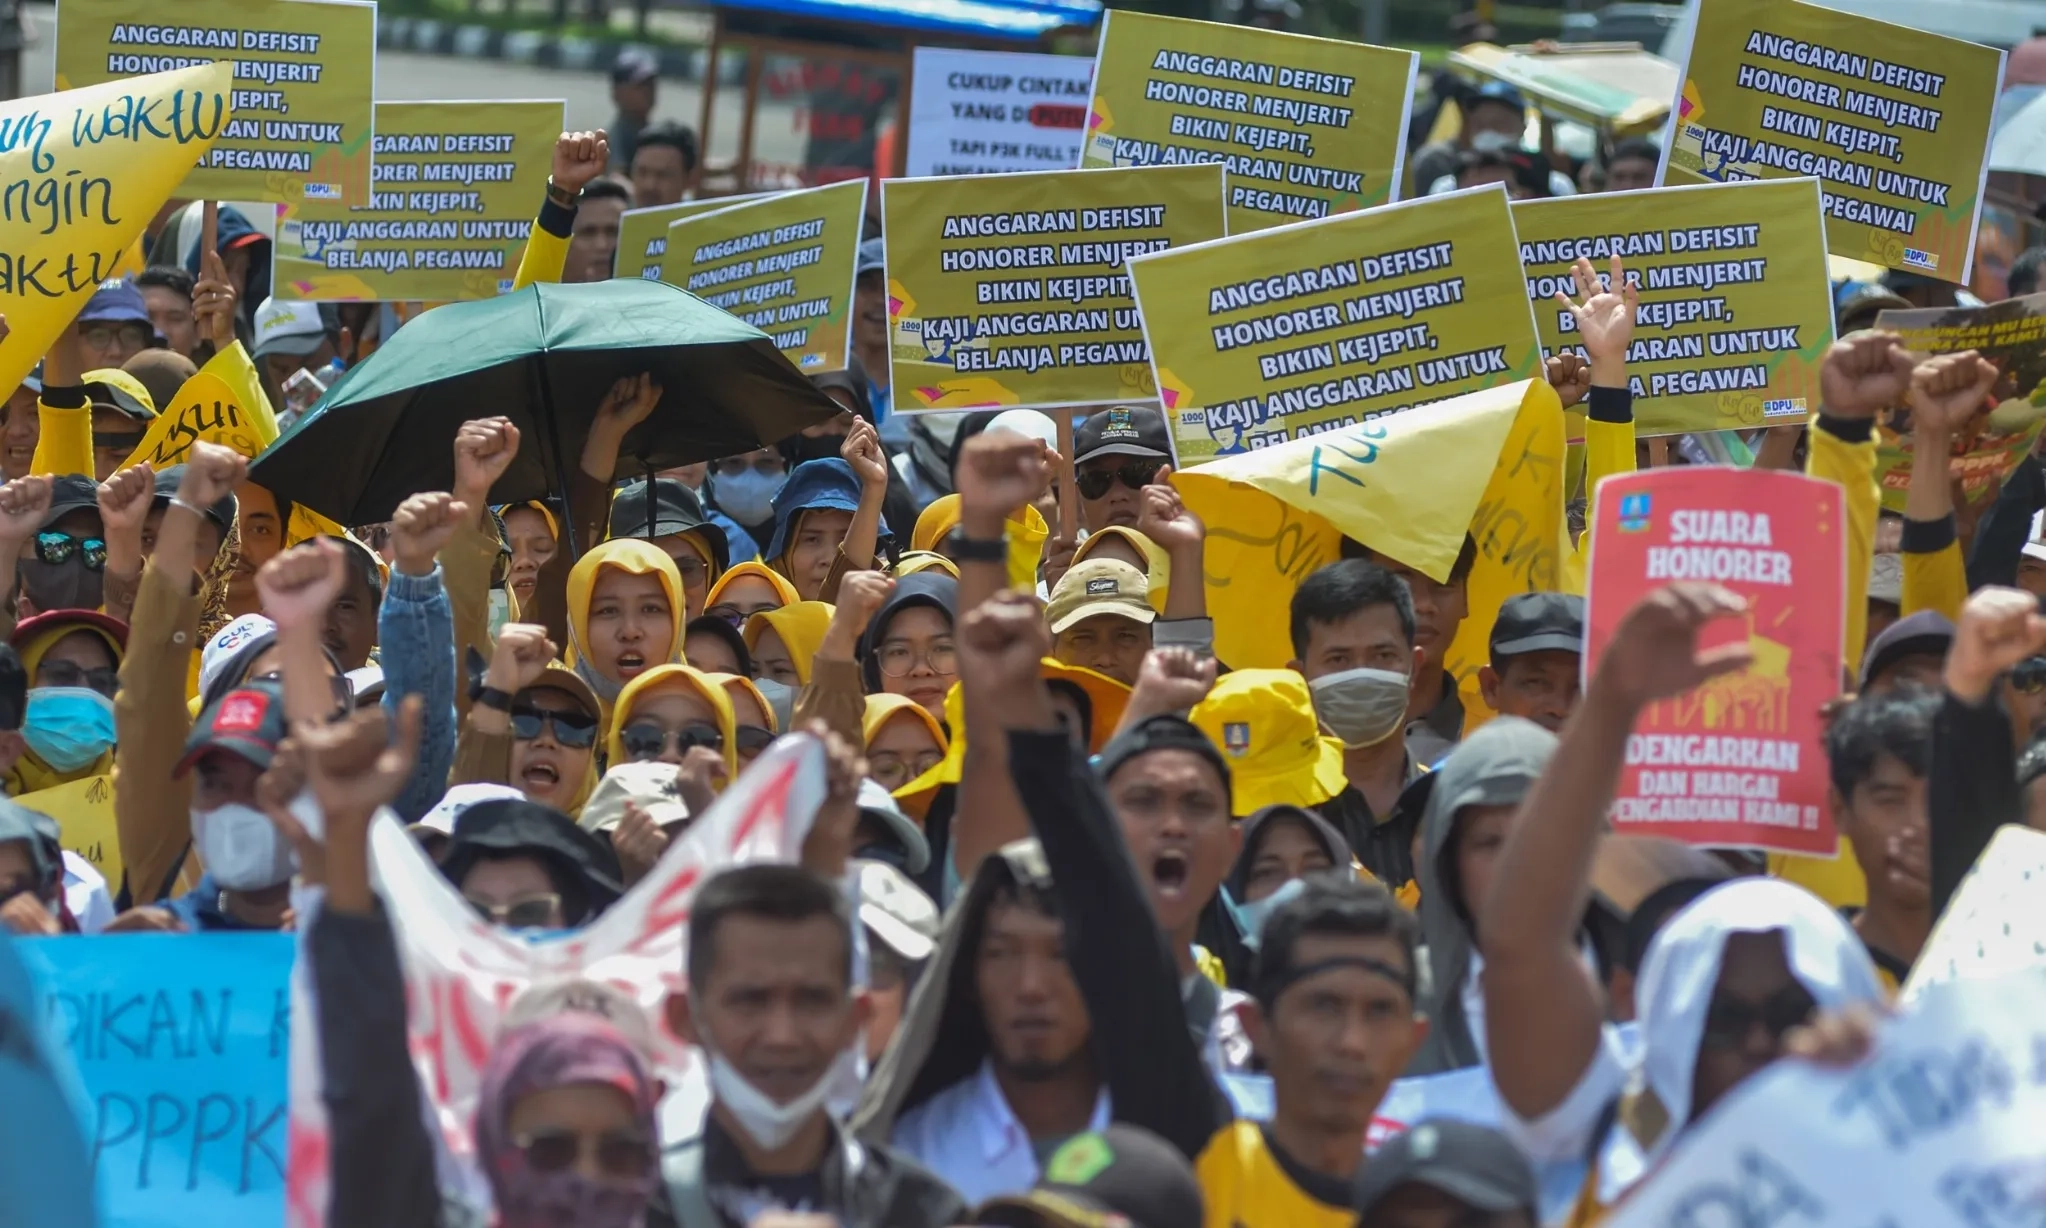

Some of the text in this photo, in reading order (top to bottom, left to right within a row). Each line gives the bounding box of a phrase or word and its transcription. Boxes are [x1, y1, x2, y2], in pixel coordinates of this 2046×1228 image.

[111, 24, 319, 53] ANGGARAN DEFISIT
[1153, 50, 1353, 97] ANGGARAN DEFISIT
[1746, 31, 1946, 97] ANGGARAN DEFISIT
[947, 72, 1013, 91] CUKUP
[951, 103, 1006, 122] YANG
[1146, 80, 1351, 128] HONORER MENJERIT
[1738, 65, 1941, 132] HONORER MENJERIT
[265, 122, 342, 142] UNTUK
[373, 135, 513, 152] GARAN DEFISIT
[1170, 115, 1315, 156] BIKIN KEJEPIT,
[1685, 125, 1704, 138] 1000
[1761, 107, 1903, 161] BIKIN KEJEPIT,
[211, 150, 311, 172] PEGAWAI
[373, 164, 514, 184] ORER MENJERIT
[1115, 138, 1158, 165] KAJI
[1288, 164, 1363, 192] UNTUK
[1704, 128, 1949, 207] KAJI ANGGARAN UNTUK
[408, 192, 484, 213] KEJEPIT,
[1232, 187, 1329, 218] PEGAWAI
[1822, 193, 1916, 235] PEGAWAI
[303, 222, 341, 243] KAJI
[348, 222, 457, 239] ANGGARAN
[463, 222, 530, 238] UNTUK
[943, 206, 1164, 237] ANGGARAN DEFISIT
[693, 231, 770, 264] ANGGARAN
[773, 218, 824, 246] DEFISIT
[1520, 225, 1759, 263] ANGGARAN DEFISIT
[326, 250, 503, 272] BELANJA PEGAWAI
[688, 260, 753, 291] HONORER
[756, 247, 822, 275] MENJERIT
[943, 247, 1054, 270] HONORER
[1210, 243, 1453, 314] ANGGARAN DEFISIT
[1649, 259, 1766, 290] MENJERIT
[977, 281, 1041, 302] BIKIN
[779, 299, 829, 323] UNTUK
[901, 321, 921, 332] 1000
[923, 317, 969, 341] KAJI
[975, 312, 1107, 336] ANGGARAN
[1213, 280, 1464, 351] HONORER MENJERIT
[1636, 297, 1733, 329] KEJEPIT,
[1260, 324, 1438, 380] BIKIN KEJEPIT,
[1710, 328, 1799, 354] UNTUK
[955, 343, 1150, 373] BELANJA PEGAW
[1206, 397, 1261, 430] KAJI
[1267, 369, 1412, 418] ANGGARAN
[1418, 347, 1507, 386] UNTUK
[1652, 367, 1766, 396] PEGAWAI
[1181, 412, 1204, 424] 1000
[1669, 510, 1771, 545] SUARA
[1647, 547, 1792, 585] HONORER
[1625, 733, 1799, 772] DENGARKAN
[1639, 770, 1779, 800] DAN HARGAI
[92, 1092, 288, 1195] PPPK
